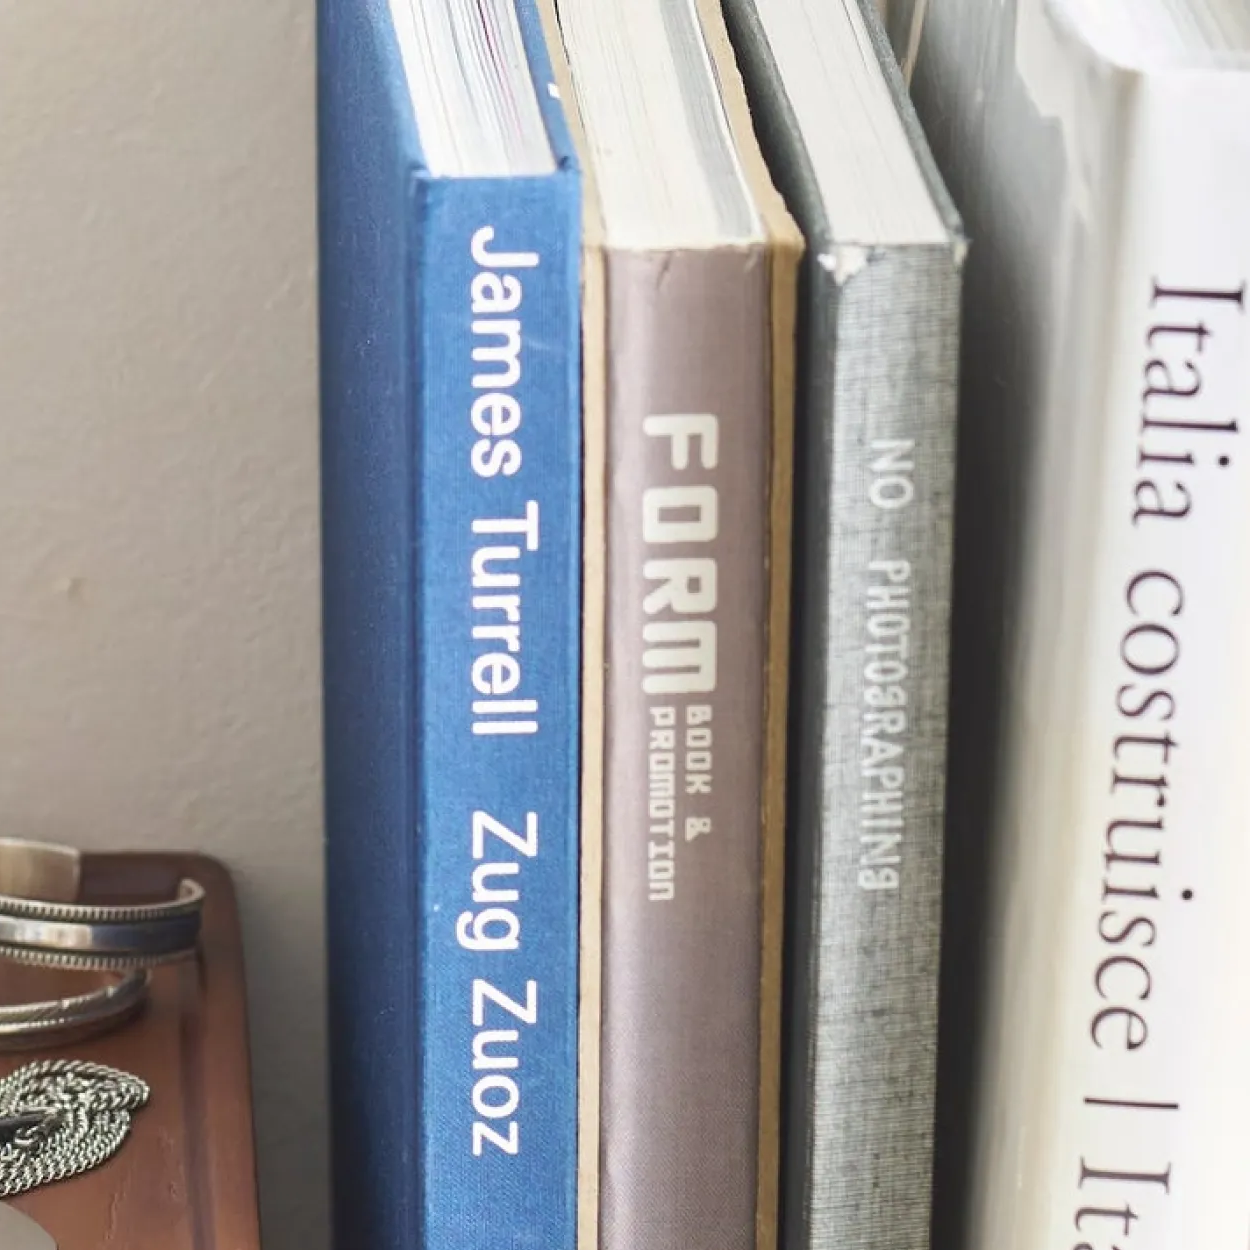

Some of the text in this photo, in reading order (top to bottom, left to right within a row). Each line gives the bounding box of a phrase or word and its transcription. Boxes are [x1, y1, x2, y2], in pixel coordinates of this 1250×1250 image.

[867, 438, 914, 511] NO
[1131, 275, 1246, 528] Italia
[641, 413, 719, 696] FORM
[455, 225, 541, 1158] James Turrell Zug Zuoz
[683, 704, 713, 842] BOOK &
[1089, 568, 1194, 1053] costruisce
